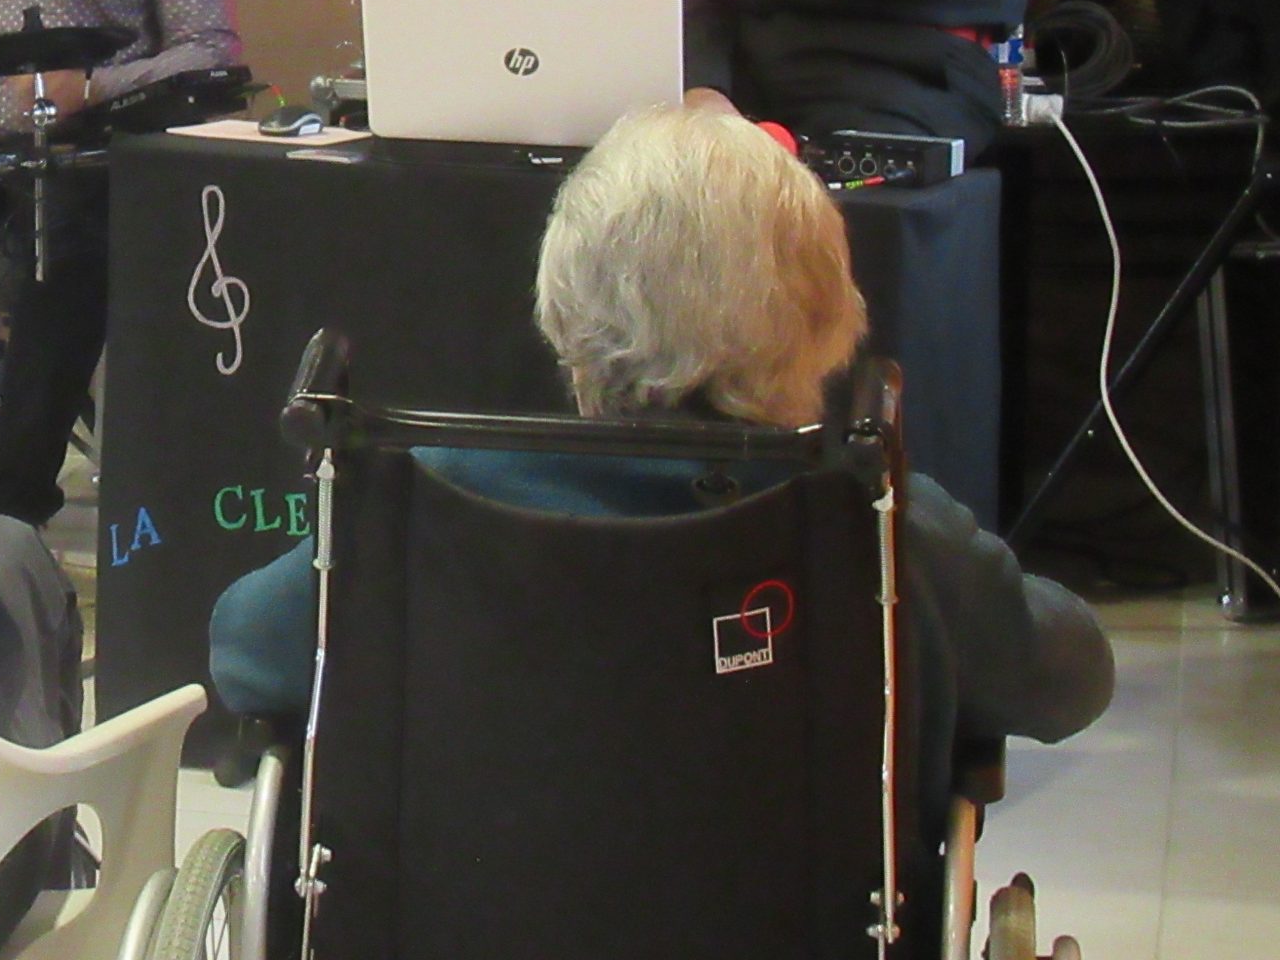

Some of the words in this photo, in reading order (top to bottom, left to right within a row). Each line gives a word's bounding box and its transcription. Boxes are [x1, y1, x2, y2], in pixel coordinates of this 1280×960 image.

[507, 48, 537, 76] hp
[109, 506, 162, 567] LA
[213, 484, 311, 536] CLE
[718, 648, 770, 670] DUPONT
